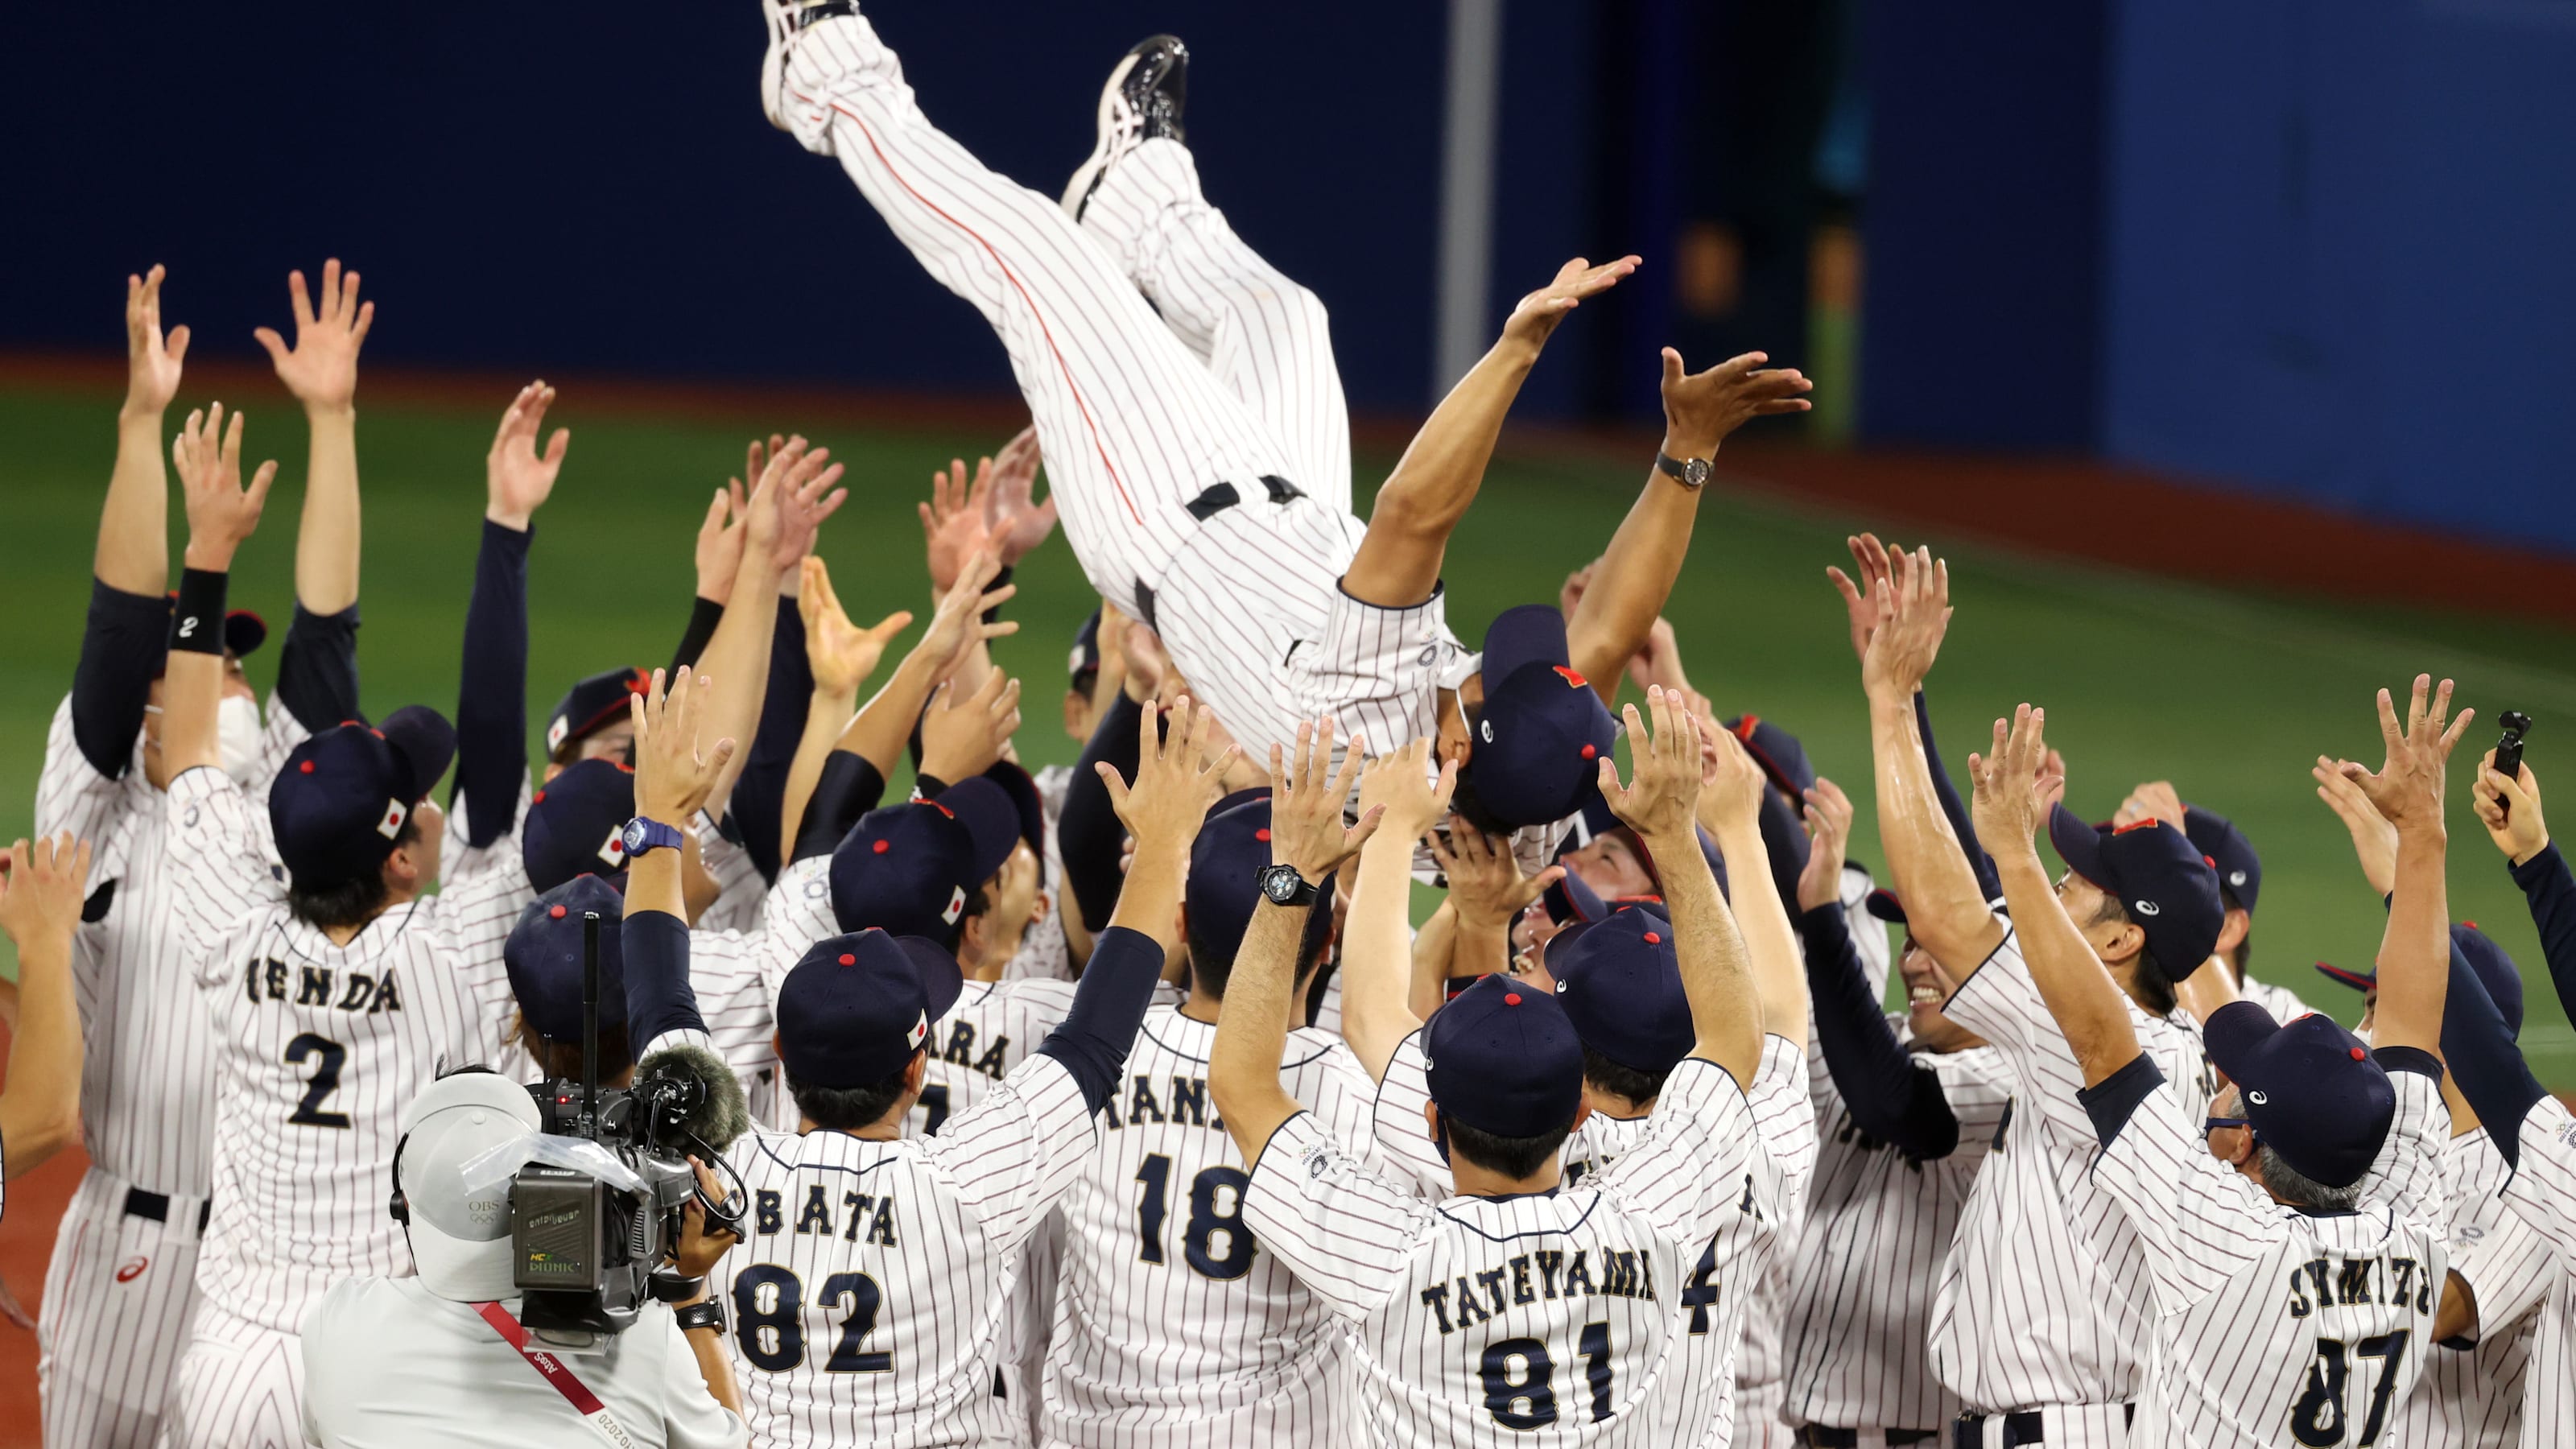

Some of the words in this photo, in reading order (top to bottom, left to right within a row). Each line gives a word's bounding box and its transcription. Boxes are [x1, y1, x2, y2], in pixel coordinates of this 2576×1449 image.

[179, 616, 199, 638] 2
[284, 1031, 352, 1129] 2
[469, 1200, 499, 1212] OBS
[730, 1184, 898, 1248] BATA
[1134, 1151, 1259, 1282] 18
[731, 1262, 894, 1374] 82
[1476, 1319, 1616, 1432] 81
[2289, 1327, 2412, 1449] 87
[598, 1414, 623, 1439] 2020
